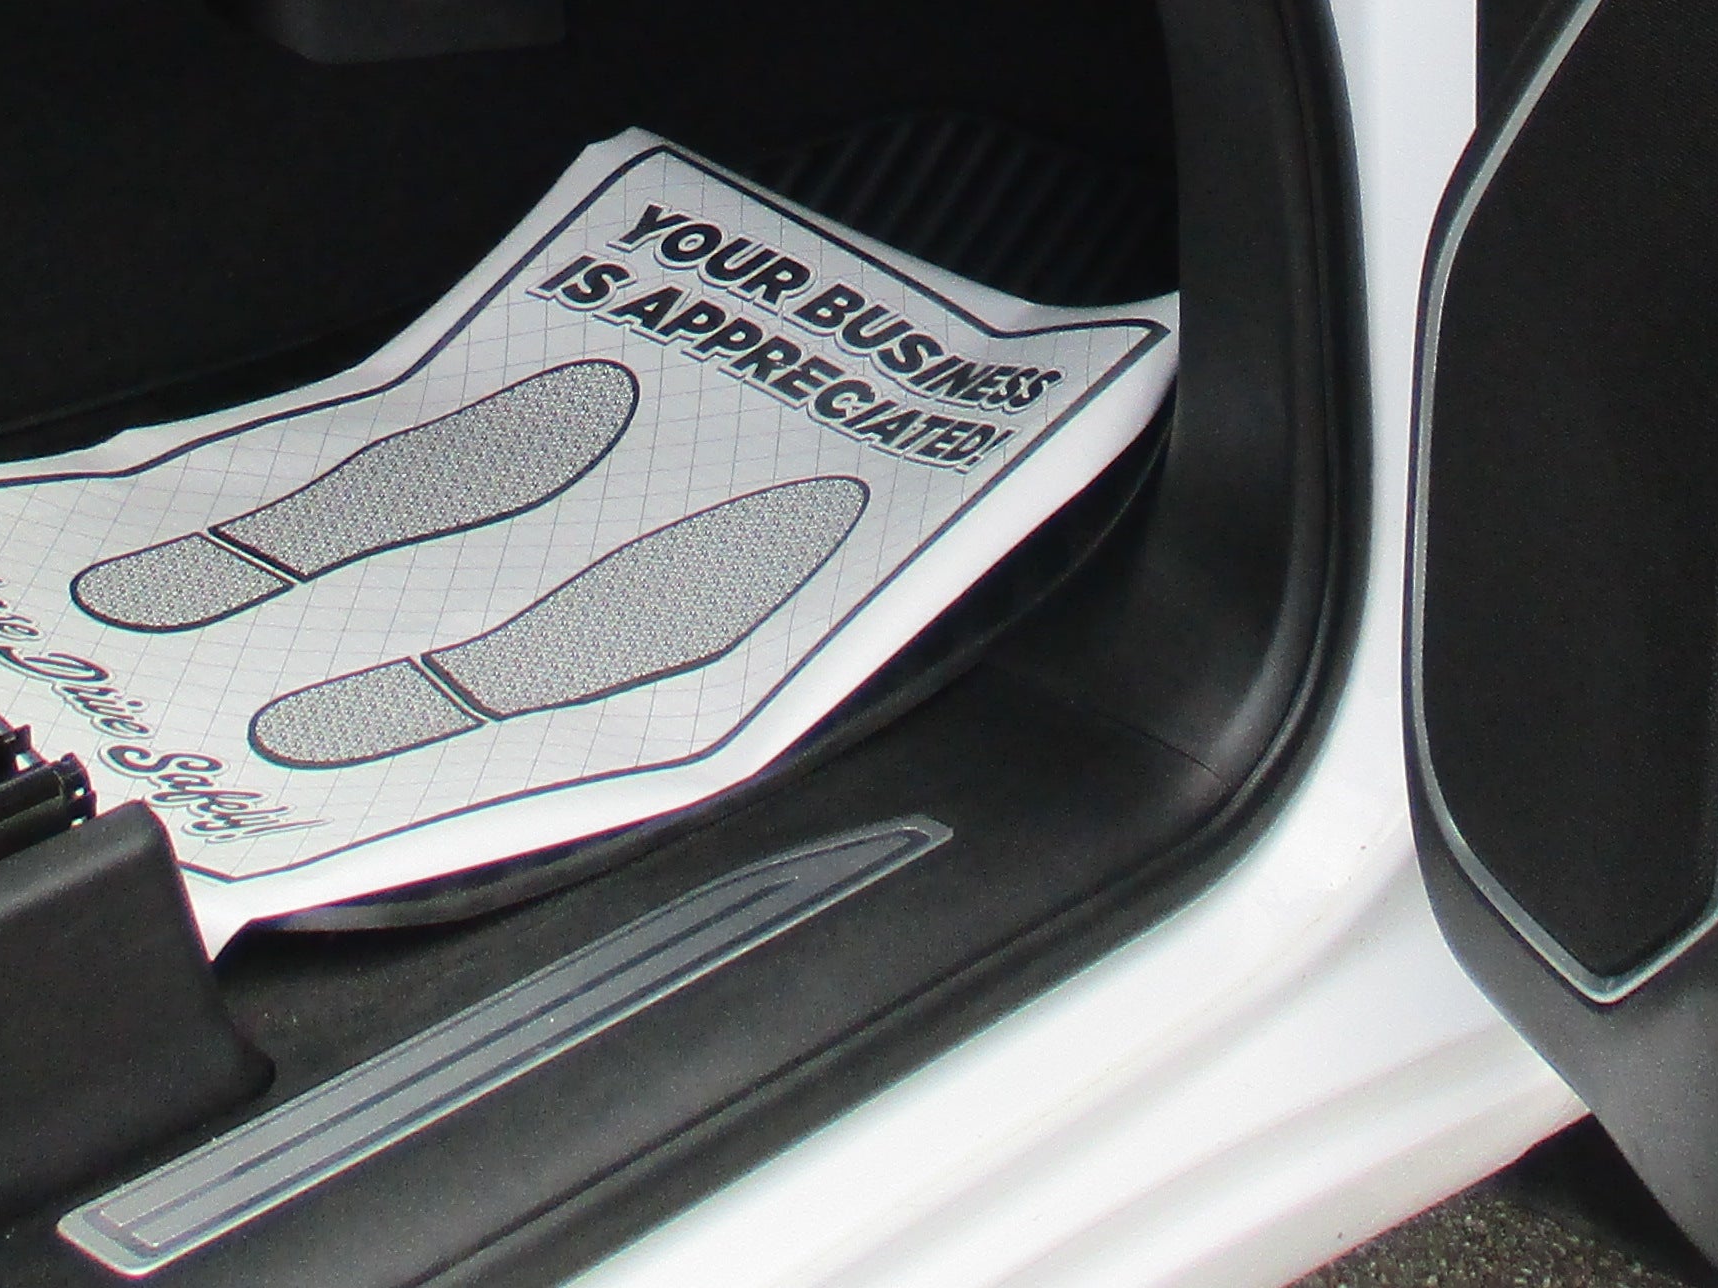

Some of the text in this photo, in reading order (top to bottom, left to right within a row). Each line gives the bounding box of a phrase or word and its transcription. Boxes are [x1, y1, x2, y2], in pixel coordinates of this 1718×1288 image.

[527, 254, 1017, 472] IS APPRECIATED!
[609, 202, 1066, 412] YOUR BUSINESS
[101, 743, 328, 843] Safely!
